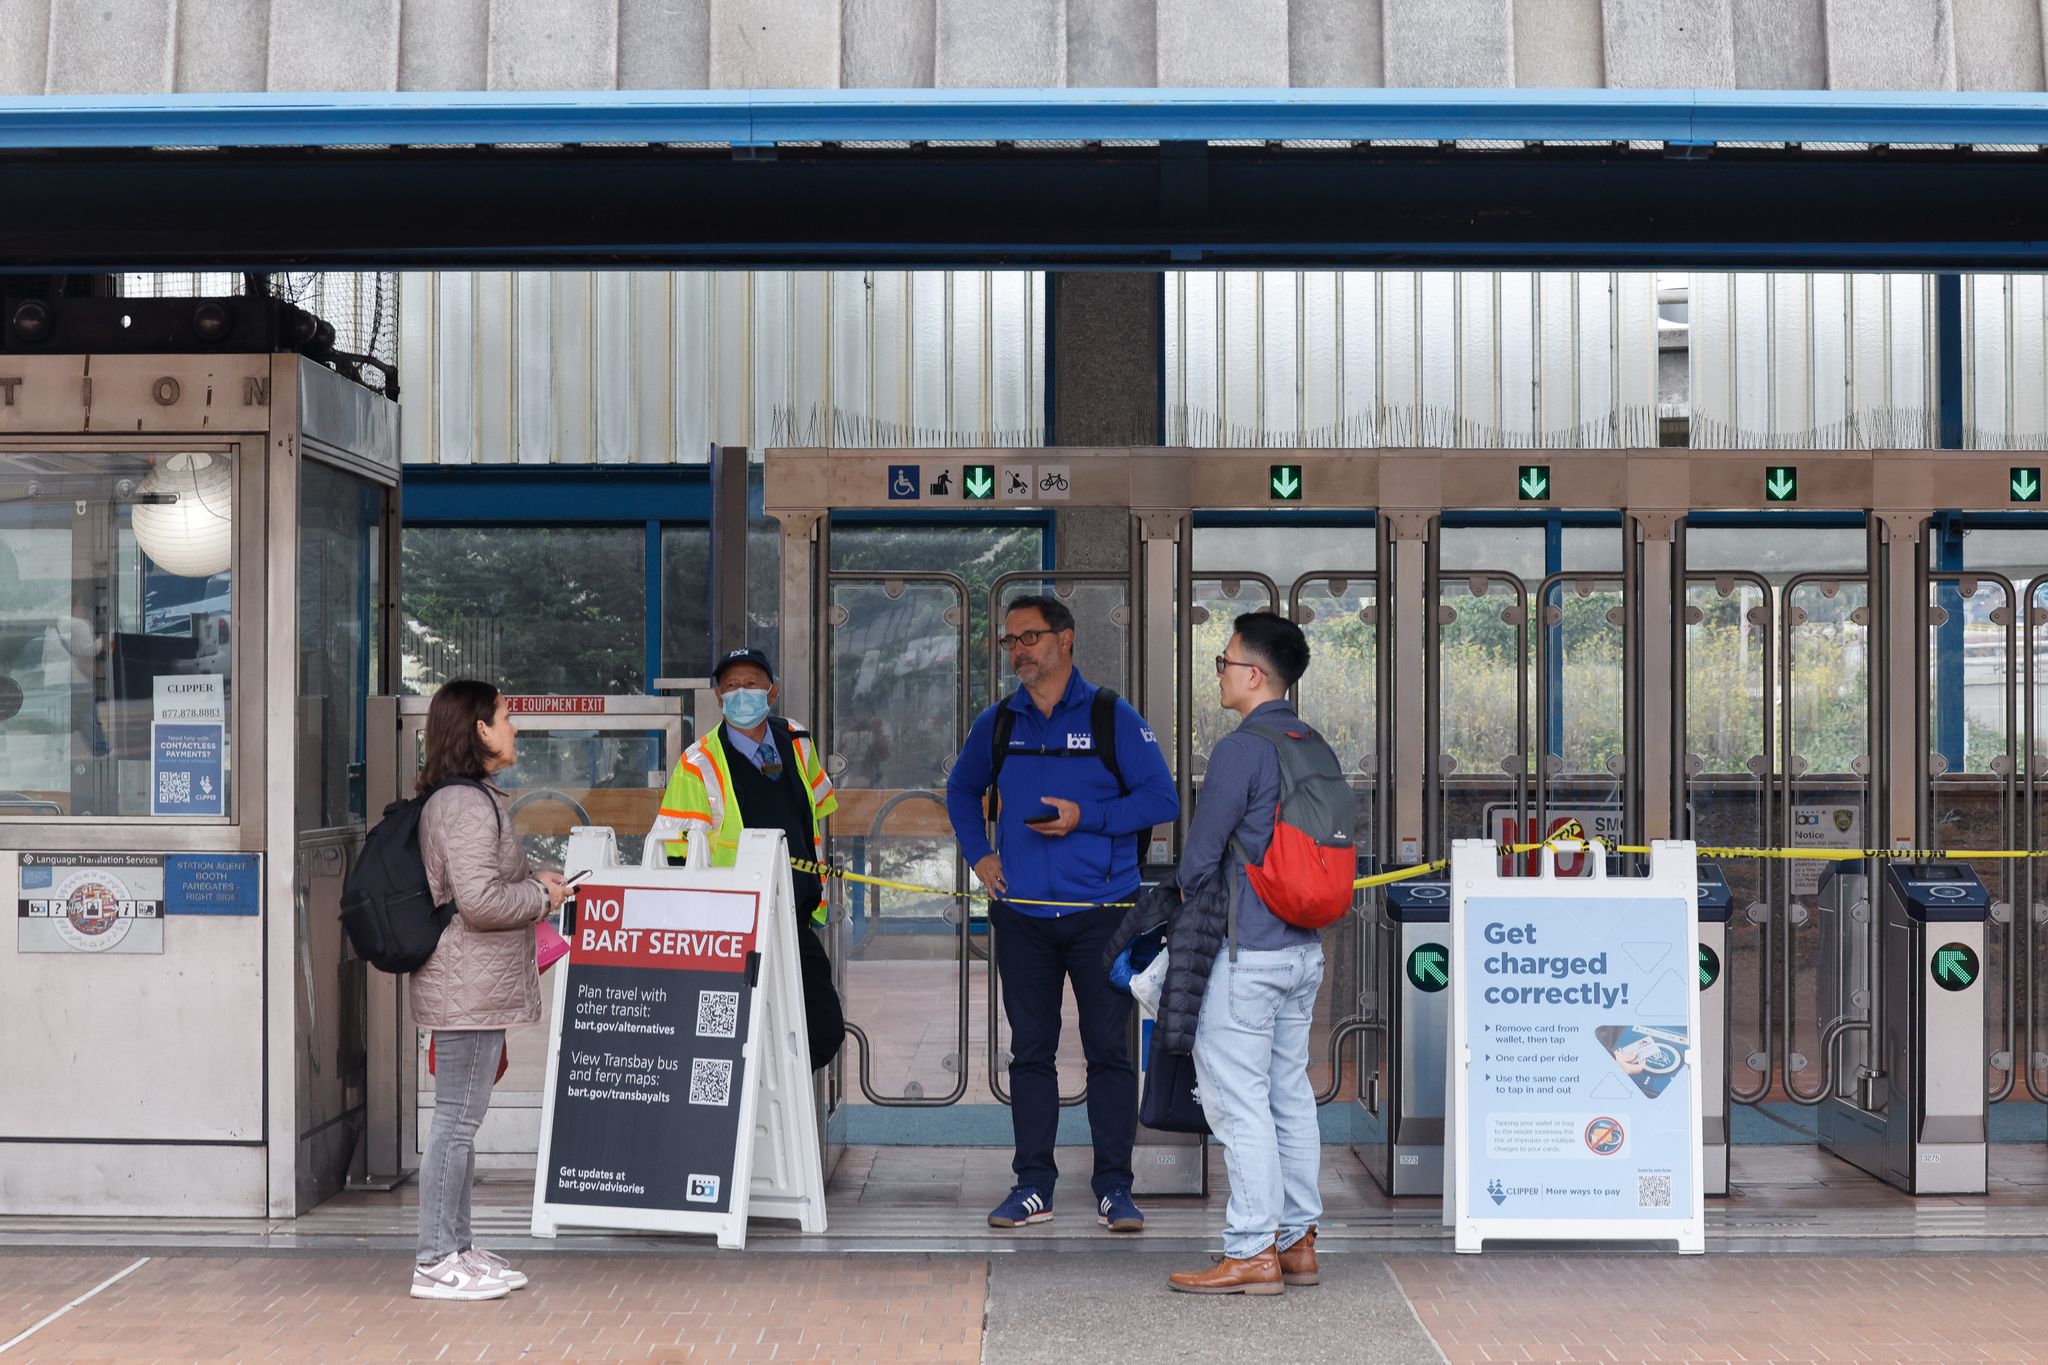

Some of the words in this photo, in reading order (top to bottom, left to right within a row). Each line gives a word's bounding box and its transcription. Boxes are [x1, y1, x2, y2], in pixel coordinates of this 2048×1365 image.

[167, 684, 213, 693] CLIPPER
[522, 698, 578, 711] EQUIPMENT
[581, 698, 603, 711] EXIT
[161, 708, 220, 719] 877.878.8883
[165, 750, 210, 758] PAYMENTS?
[1795, 831, 1824, 839] Notice
[36, 855, 77, 865] Language
[79, 856, 124, 864] Translation
[126, 855, 158, 864] Services
[177, 861, 214, 870] STATION
[216, 862, 246, 870] AGENT
[195, 872, 227, 880] BOOTH
[182, 882, 234, 890] FAREGATES
[185, 892, 213, 900] RIGHT
[216, 892, 235, 900] SIDE
[584, 899, 620, 923] NO
[1484, 922, 1537, 945] Get
[581, 930, 645, 953] BART
[649, 933, 744, 958] SERVICE
[1484, 952, 1608, 979] charged
[577, 984, 602, 999] Plan
[606, 986, 638, 1001] travel
[641, 988, 667, 1002] with
[1484, 982, 1629, 1009] correctly!
[576, 1002, 608, 1017] other
[611, 1003, 651, 1018] transit:
[574, 1019, 675, 1036] bart.gov/alternatives
[1495, 1024, 1532, 1033] Remove
[1535, 1024, 1555, 1033] card
[1557, 1024, 1579, 1033] from
[1496, 1035, 1525, 1045] wallet,
[1527, 1035, 1548, 1044] then
[1550, 1036, 1566, 1046] tap
[571, 1051, 601, 1066] View
[603, 1053, 655, 1072] Transbay
[657, 1056, 679, 1070] bus
[1496, 1054, 1515, 1062] One
[1518, 1054, 1538, 1062] card
[1540, 1056, 1556, 1064] per
[1558, 1054, 1579, 1062] rider
[569, 1068, 592, 1083] and
[594, 1069, 622, 1086] ferry
[625, 1073, 660, 1088] maps:
[1496, 1075, 1513, 1083] Use
[1516, 1075, 1531, 1083] the
[1559, 1075, 1580, 1083] card
[567, 1087, 670, 1104] bart.gov/transbayalts
[1506, 1087, 1522, 1096] tap
[1525, 1086, 1534, 1094] in
[1536, 1086, 1554, 1094] and
[560, 1166, 576, 1178] Get
[577, 1167, 613, 1182] updates
[616, 1170, 626, 1180] at
[558, 1178, 645, 1195] bart.gov/advisories
[1506, 1187, 1539, 1195] CLIPPER
[1545, 1187, 1567, 1195] More
[1570, 1188, 1591, 1196] ways
[1604, 1188, 1621, 1197] pay
